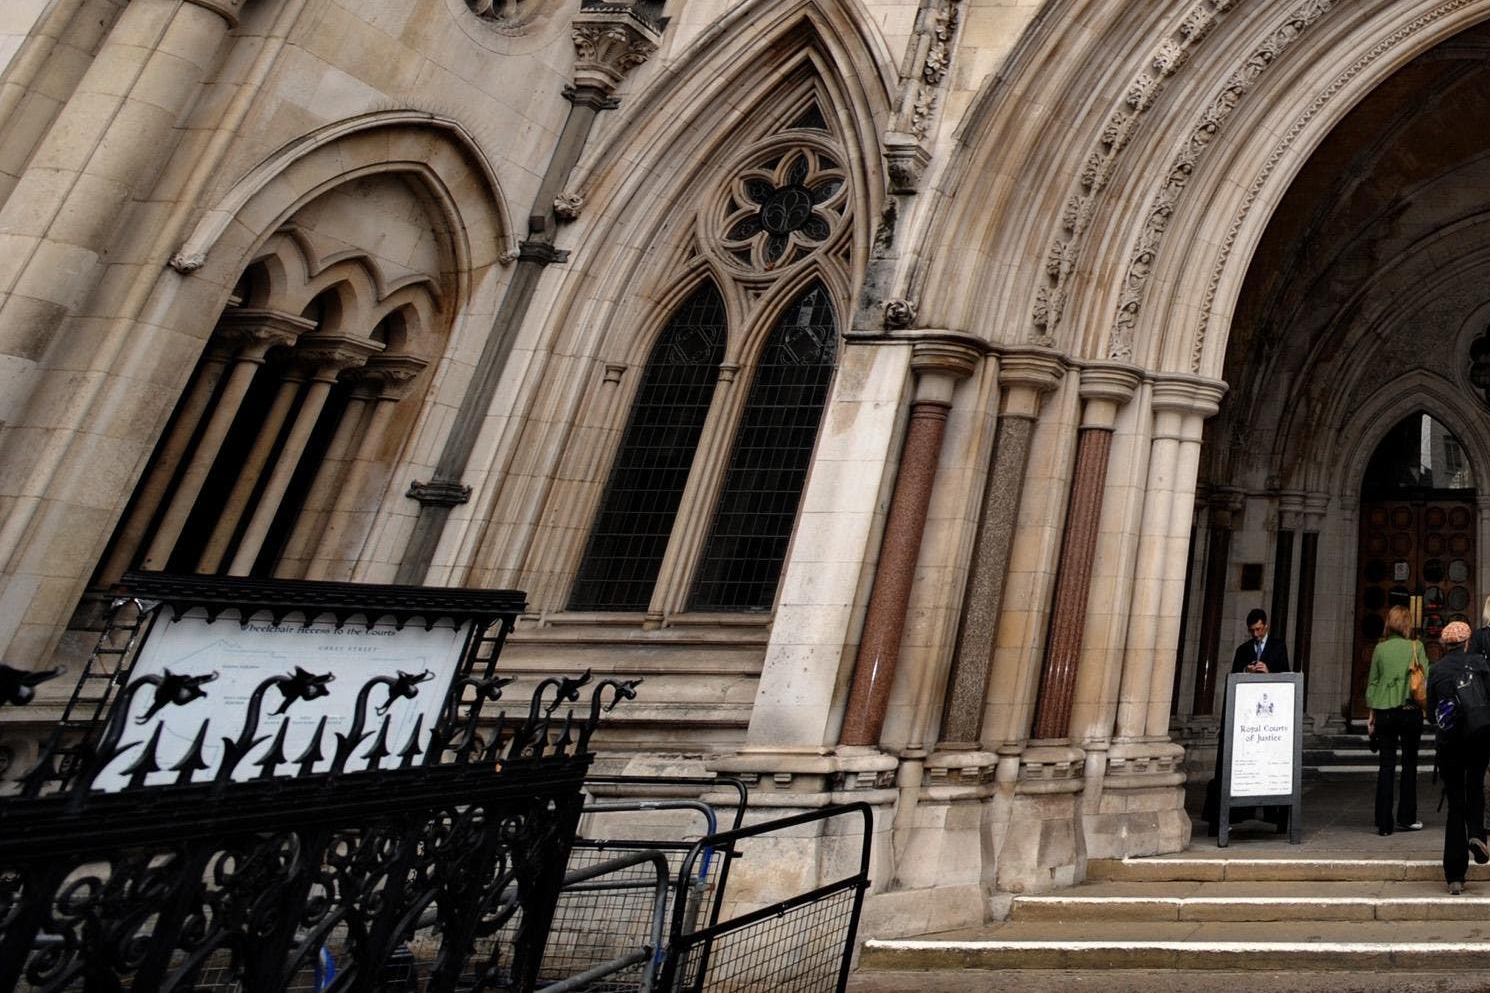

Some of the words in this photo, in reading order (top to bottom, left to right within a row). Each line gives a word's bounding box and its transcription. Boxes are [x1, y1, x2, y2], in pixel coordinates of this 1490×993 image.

[241, 623, 294, 634] Wheelchair
[297, 625, 330, 635] Access
[334, 627, 344, 636] to
[347, 627, 363, 636] the
[365, 628, 396, 637] Courts
[1240, 725, 1261, 734] Royal
[1263, 724, 1288, 733] Courts
[1245, 734, 1255, 742] of
[1256, 733, 1282, 744] Justice
